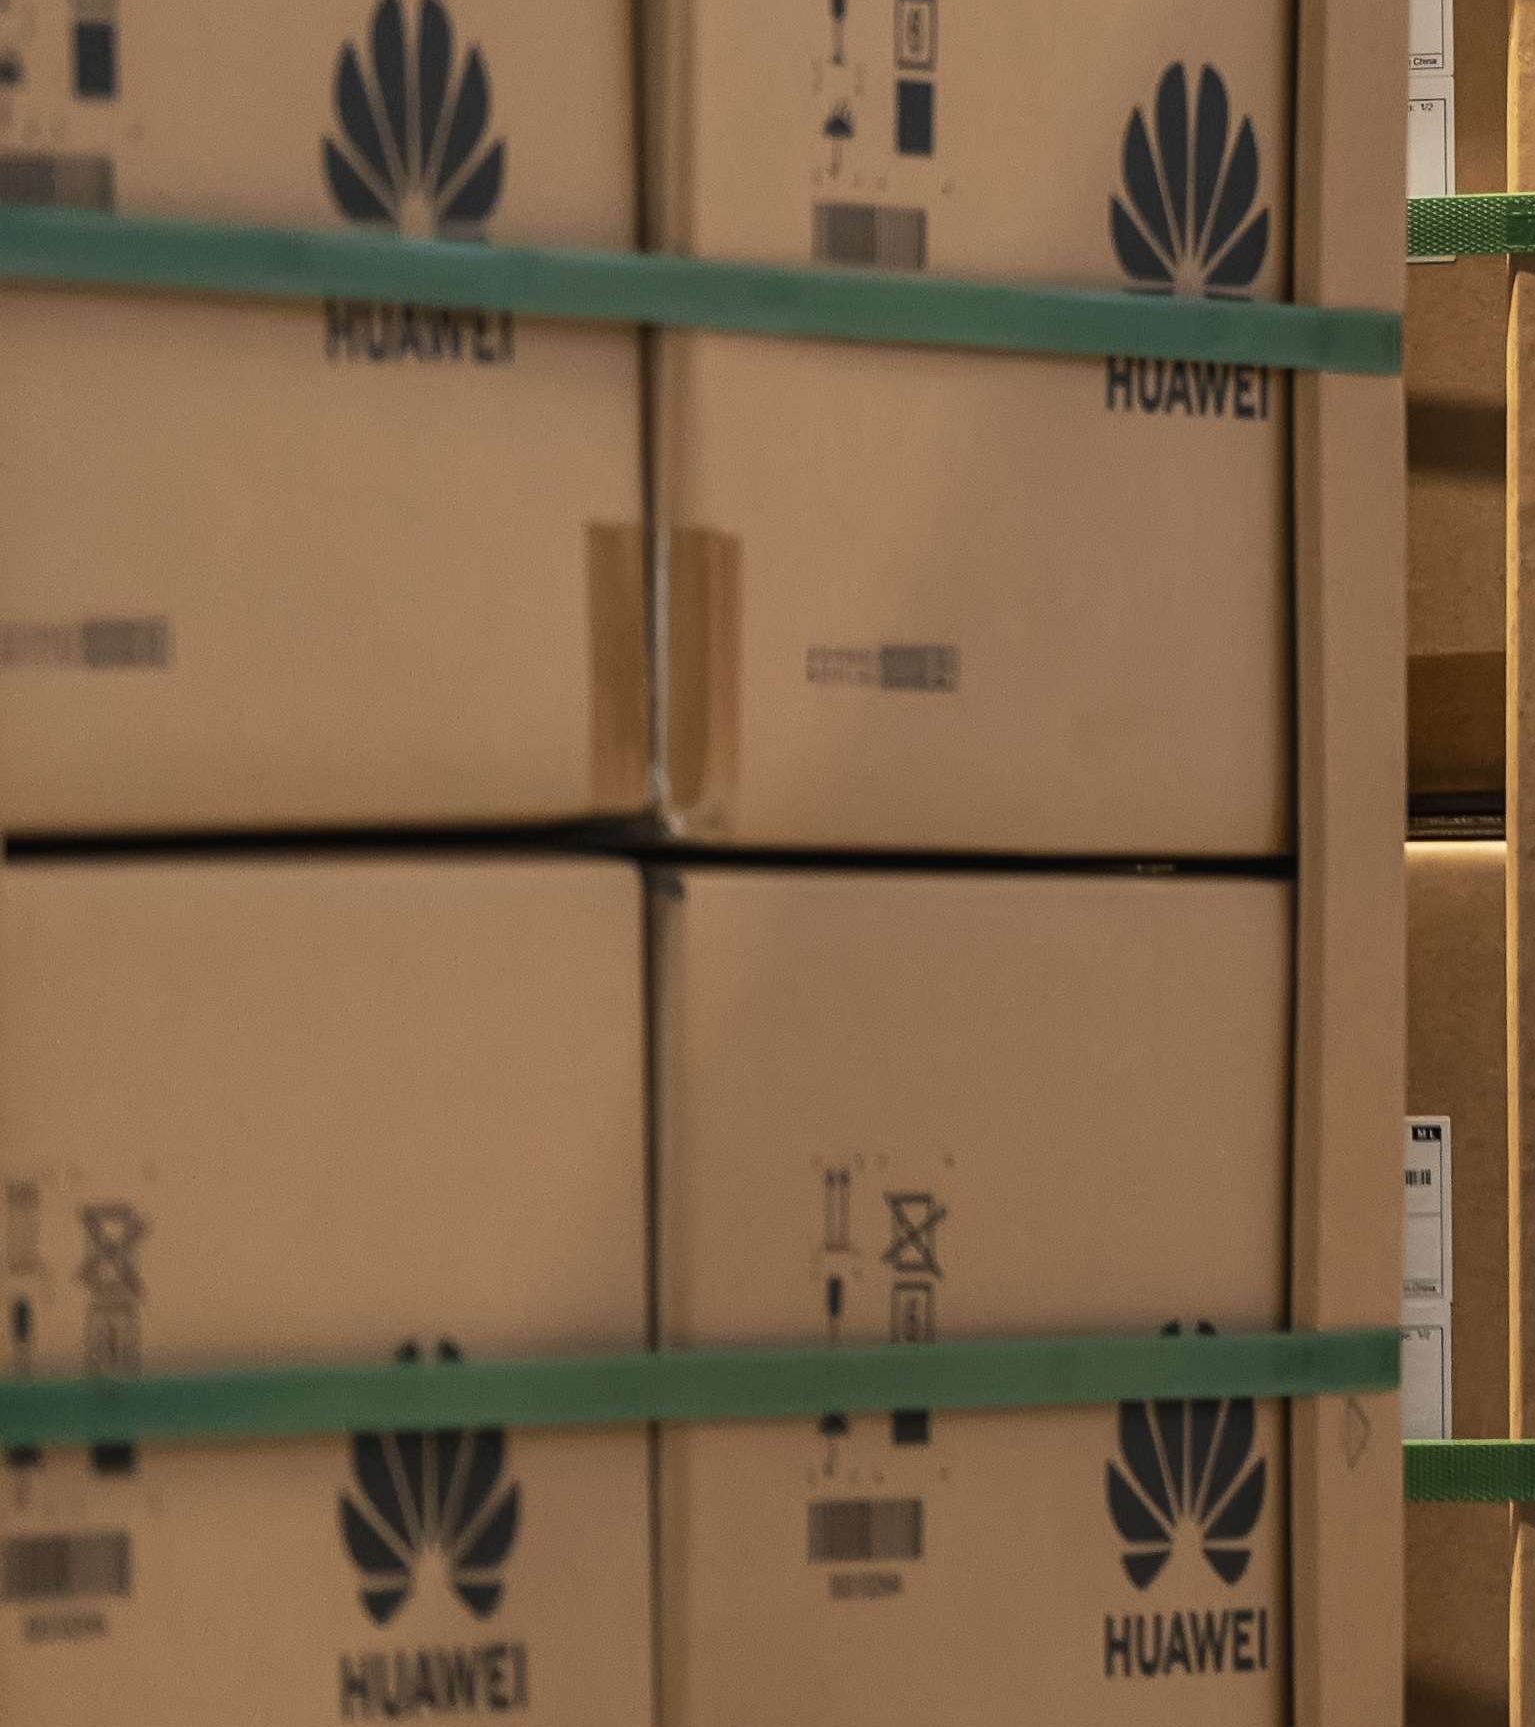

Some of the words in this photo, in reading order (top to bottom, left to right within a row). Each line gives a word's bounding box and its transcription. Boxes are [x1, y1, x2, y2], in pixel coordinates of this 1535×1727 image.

[1105, 355, 1269, 421] HUAWEI
[1104, 1608, 1267, 1678] HUAWEI
[339, 1642, 528, 1719] HUAWEI
